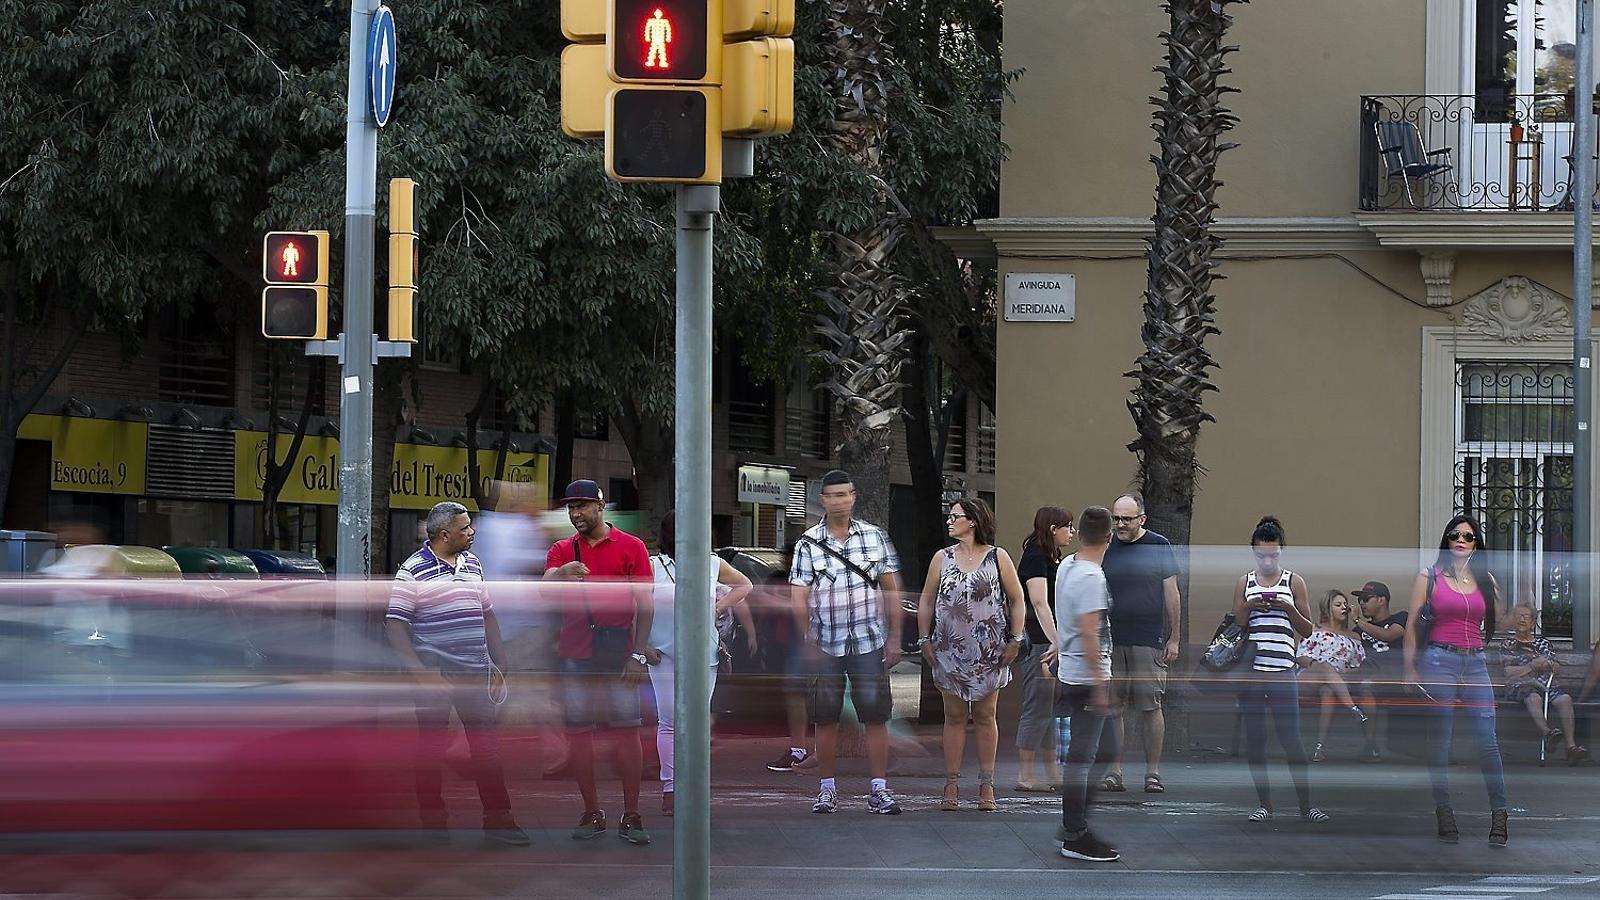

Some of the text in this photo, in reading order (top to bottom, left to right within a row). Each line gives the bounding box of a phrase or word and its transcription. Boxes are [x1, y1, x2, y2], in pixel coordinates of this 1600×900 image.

[1018, 281, 1061, 290] AVINGUDA
[1011, 303, 1066, 314] MERIDIANA
[53, 460, 127, 489] Escocia, 9
[391, 459, 419, 496] del
[422, 463, 491, 499] Tresio
